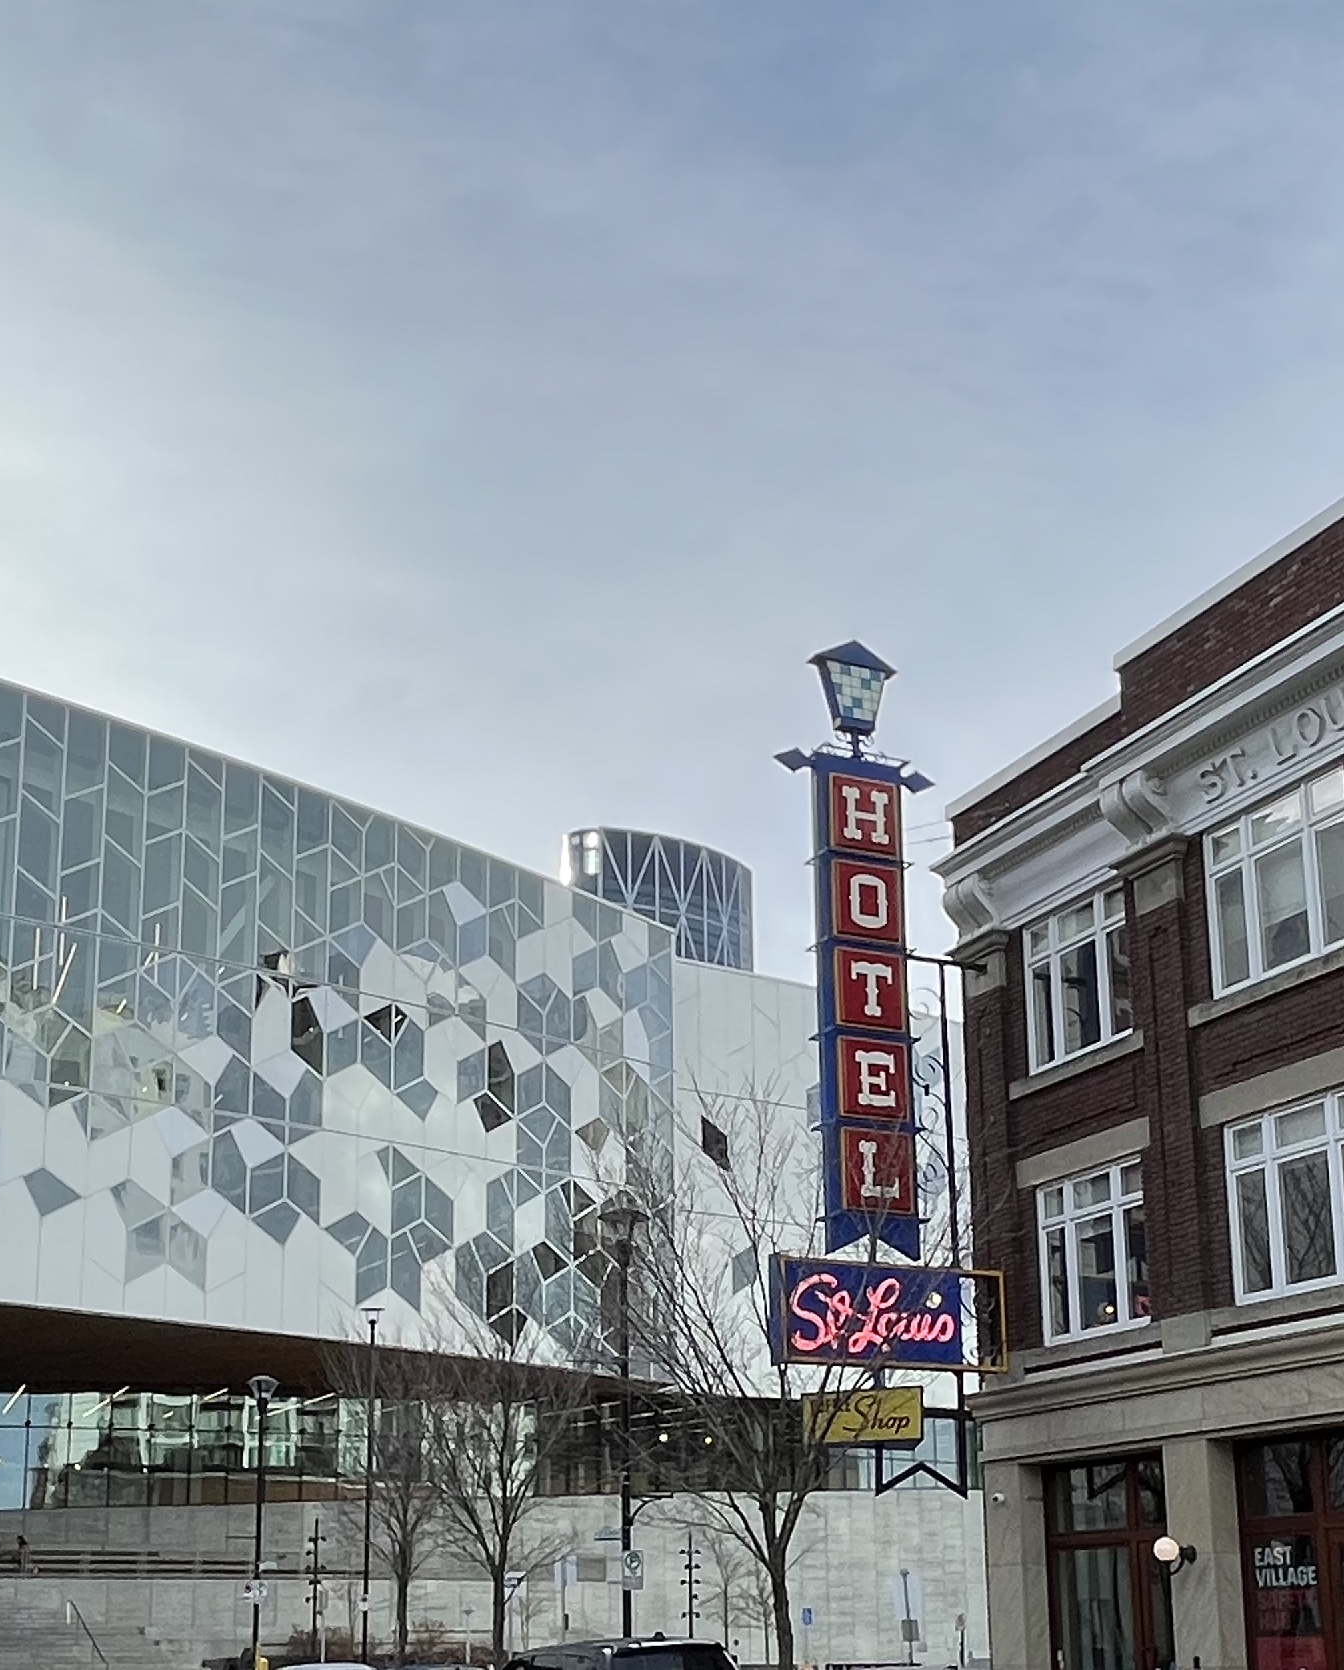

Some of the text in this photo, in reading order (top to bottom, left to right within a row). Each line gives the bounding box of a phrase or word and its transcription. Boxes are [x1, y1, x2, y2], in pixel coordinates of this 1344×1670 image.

[1199, 747, 1258, 804] ST.
[842, 785, 900, 1201] HOTEL
[848, 1276, 956, 1354] Louis
[842, 1393, 912, 1440] Shop
[1254, 1545, 1292, 1567] EAST
[1256, 1565, 1318, 1588] VILLAGE
